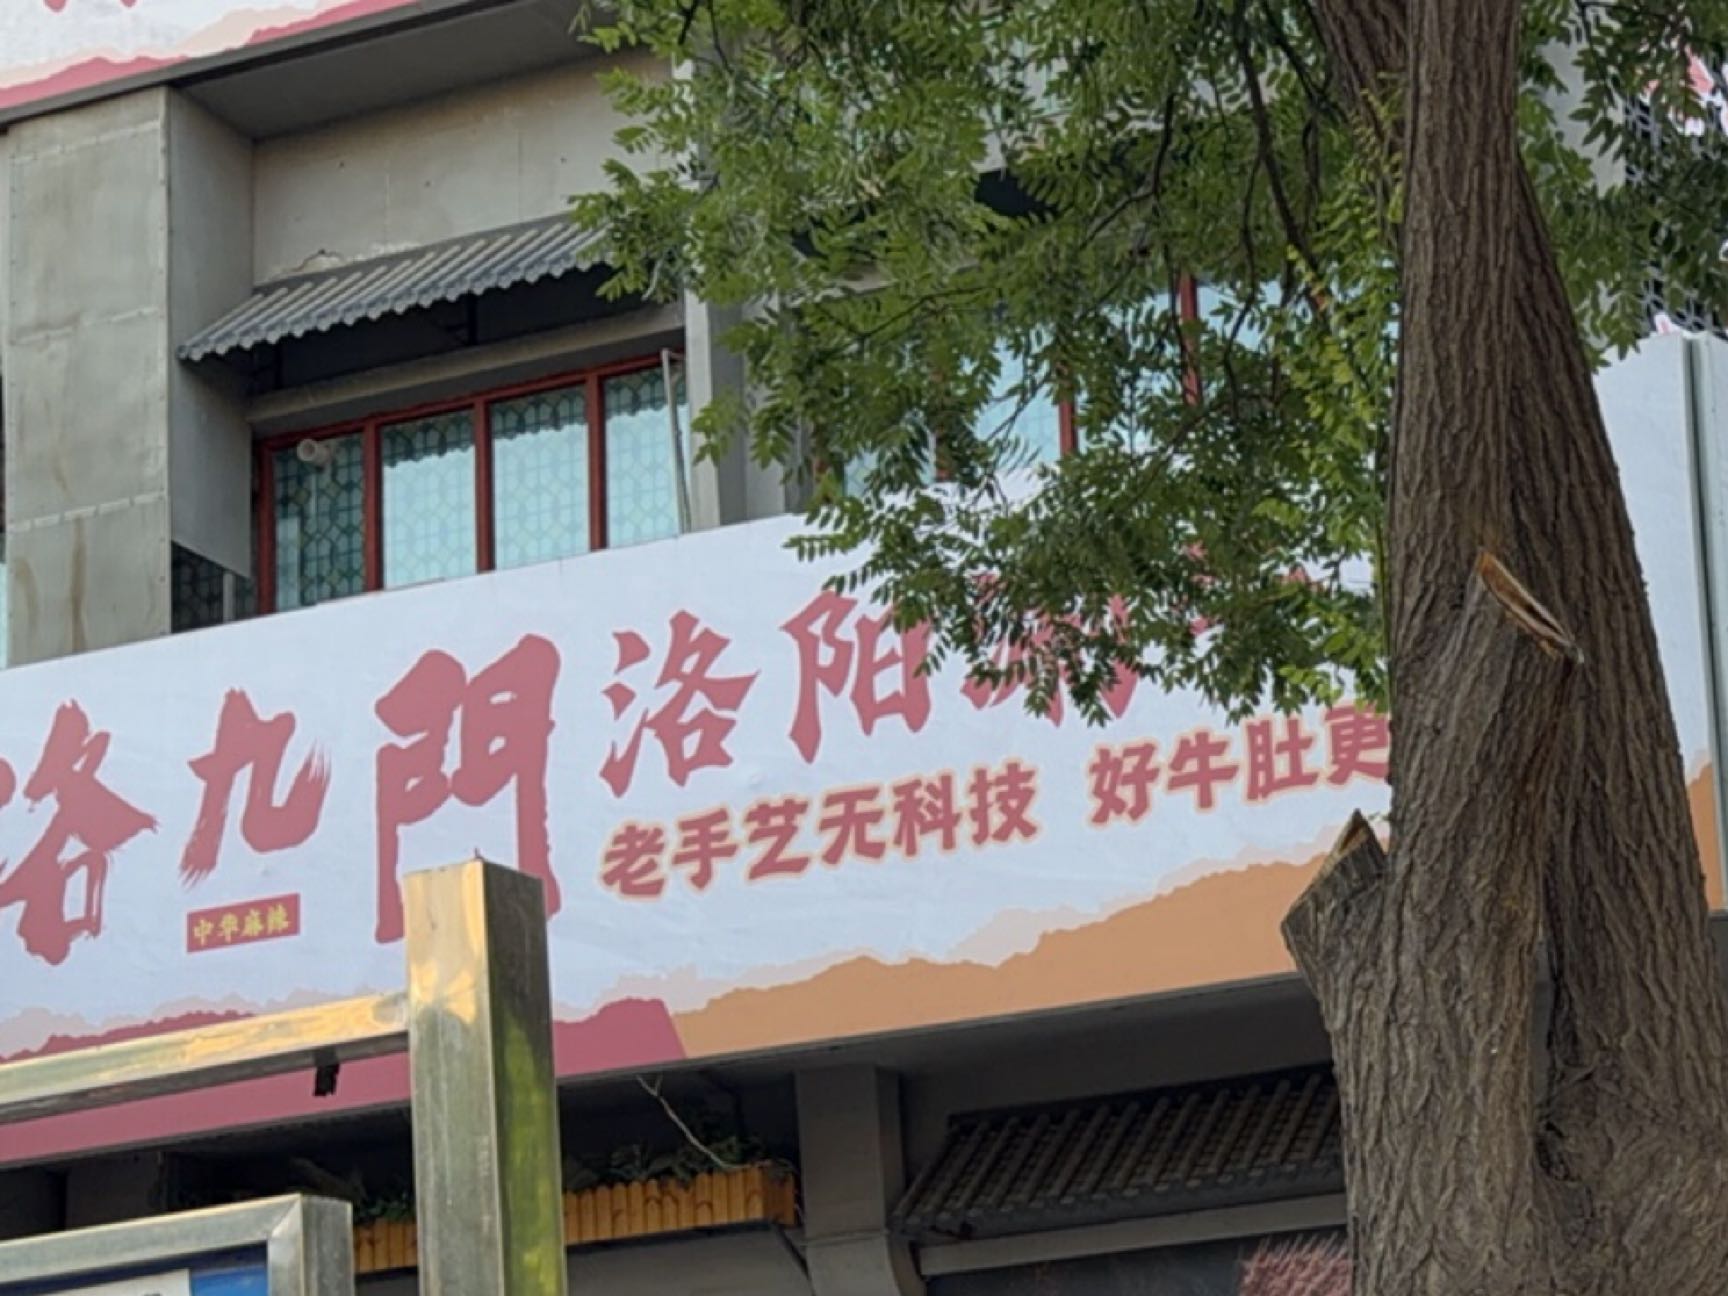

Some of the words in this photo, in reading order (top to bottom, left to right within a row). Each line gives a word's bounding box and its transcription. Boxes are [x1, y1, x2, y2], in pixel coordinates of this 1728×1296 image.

[602, 760, 1040, 900] 老手艺无科技
